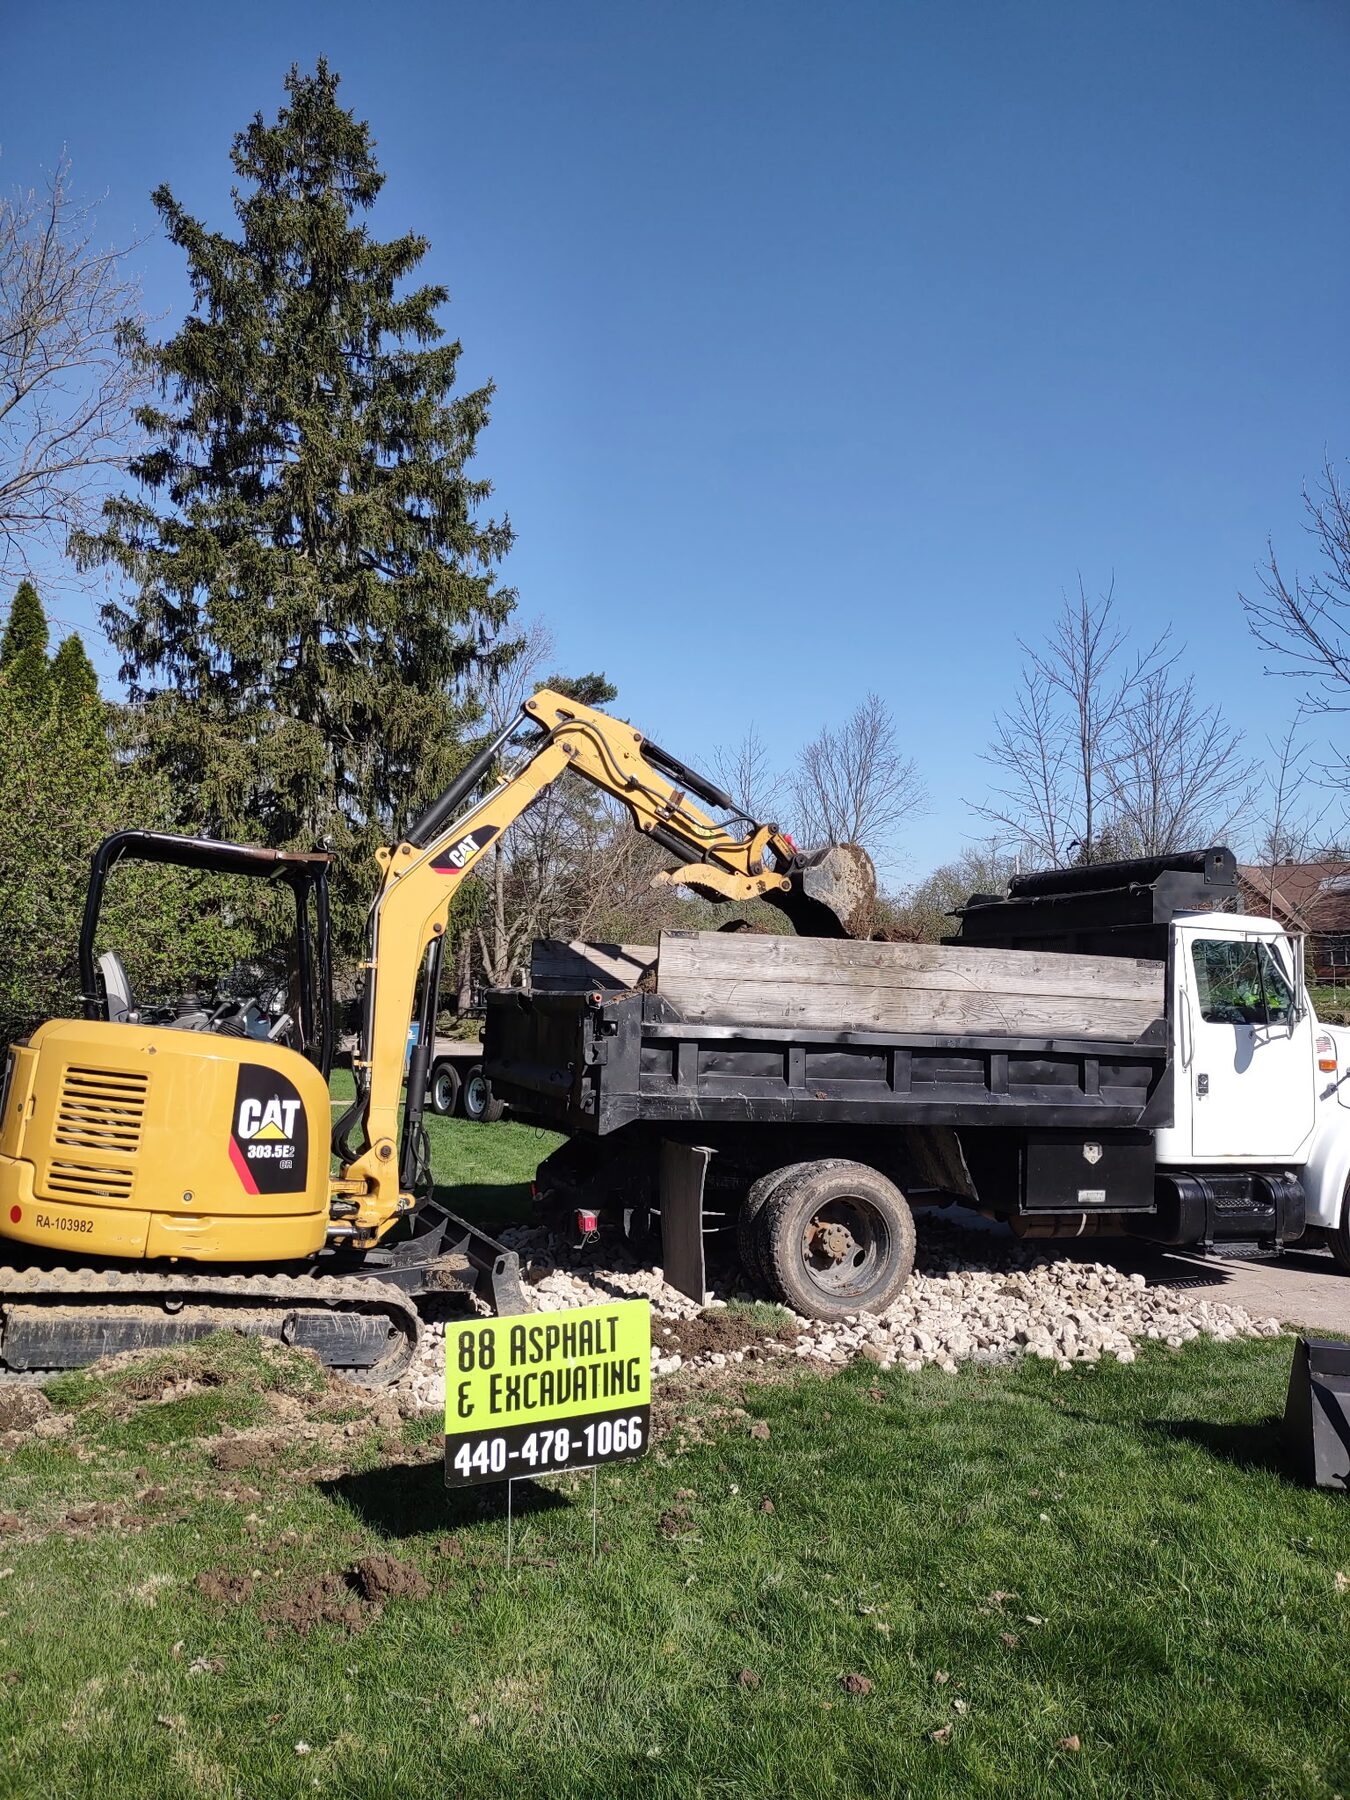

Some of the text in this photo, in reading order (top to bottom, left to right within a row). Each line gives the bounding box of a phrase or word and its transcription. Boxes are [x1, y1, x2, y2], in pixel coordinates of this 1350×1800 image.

[449, 834, 480, 868] CAT
[238, 1098, 301, 1139] CAT
[36, 1214, 94, 1233] RA-103982
[458, 1316, 619, 1373] 88 ASPHALT
[457, 1357, 641, 1418] & EXCAVATING
[454, 1416, 642, 1477] 440-478-1066
